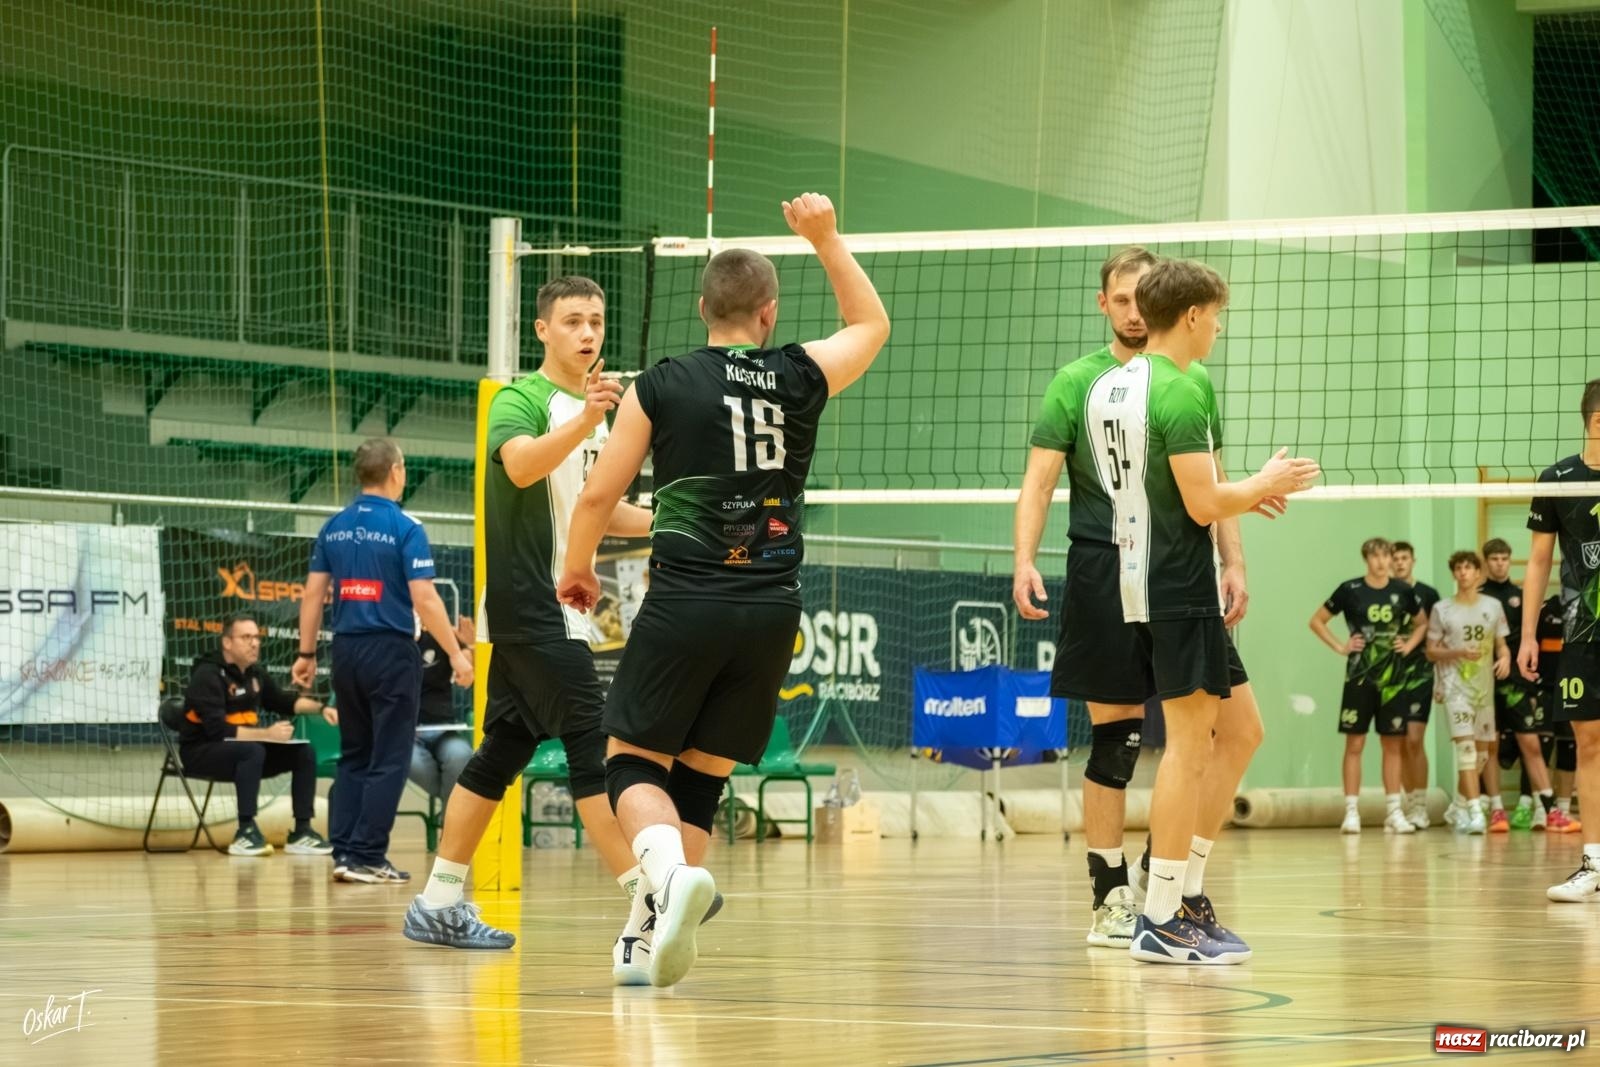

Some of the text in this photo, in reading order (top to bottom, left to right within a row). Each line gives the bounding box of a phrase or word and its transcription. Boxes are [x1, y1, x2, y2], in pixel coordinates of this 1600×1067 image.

[725, 364, 777, 390] KOSTKA
[723, 395, 787, 471] 15
[1103, 418, 1131, 490] 54
[91, 590, 149, 615] FM
[1367, 604, 1393, 623] 66
[1463, 625, 1485, 641] 38
[818, 679, 880, 701] RACIBÓRZ
[1559, 677, 1584, 700] 10
[924, 696, 986, 717] molten
